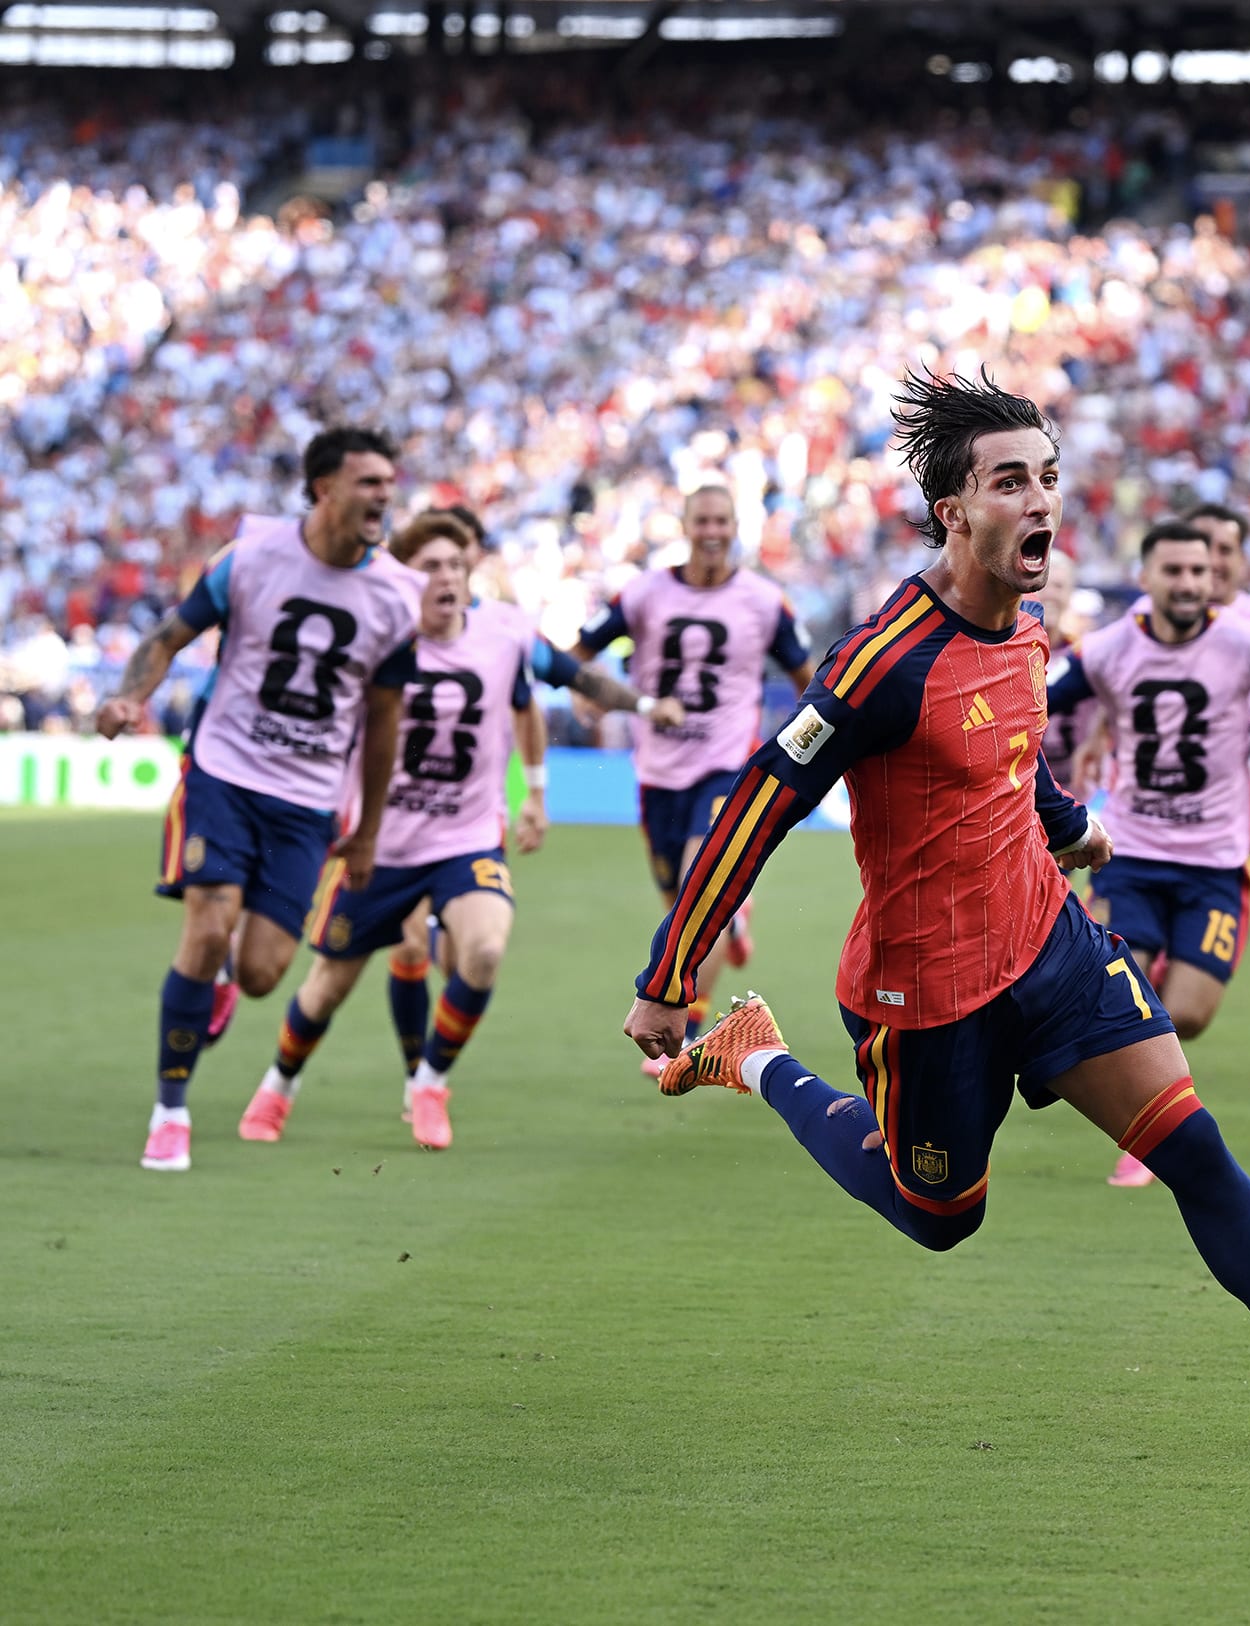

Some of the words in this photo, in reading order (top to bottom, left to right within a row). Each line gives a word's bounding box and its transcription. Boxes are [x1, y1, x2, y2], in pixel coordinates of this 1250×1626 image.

[1008, 730, 1028, 792] 7
[1200, 909, 1237, 962] 15
[1105, 957, 1152, 1021] 7
